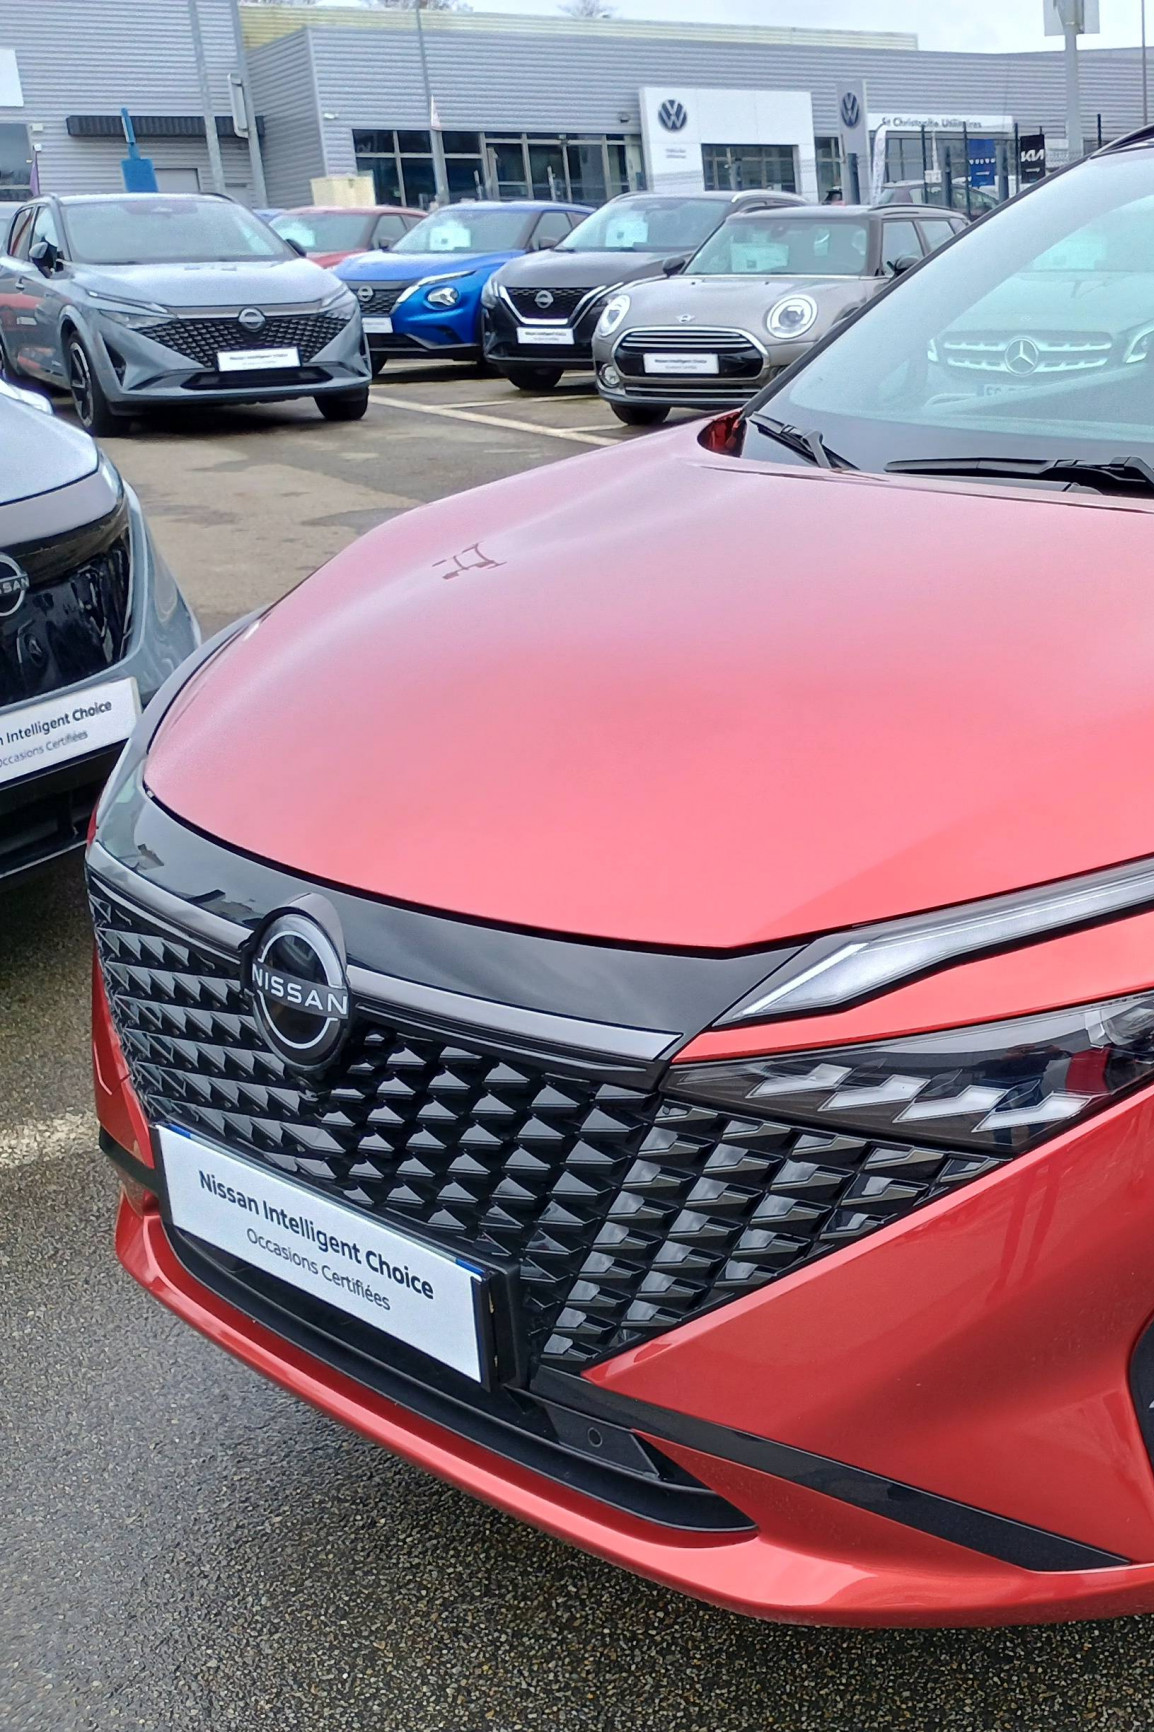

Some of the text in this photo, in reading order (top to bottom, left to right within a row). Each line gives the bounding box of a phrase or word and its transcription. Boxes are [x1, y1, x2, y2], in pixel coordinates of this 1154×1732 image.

[6, 713, 71, 744] Intelligent
[72, 701, 112, 722] Choice
[252, 963, 348, 1015] NISSAN
[199, 1170, 434, 1300] Nissan Intelligent Choice
[246, 1228, 391, 1311] Occasions Certifiées
